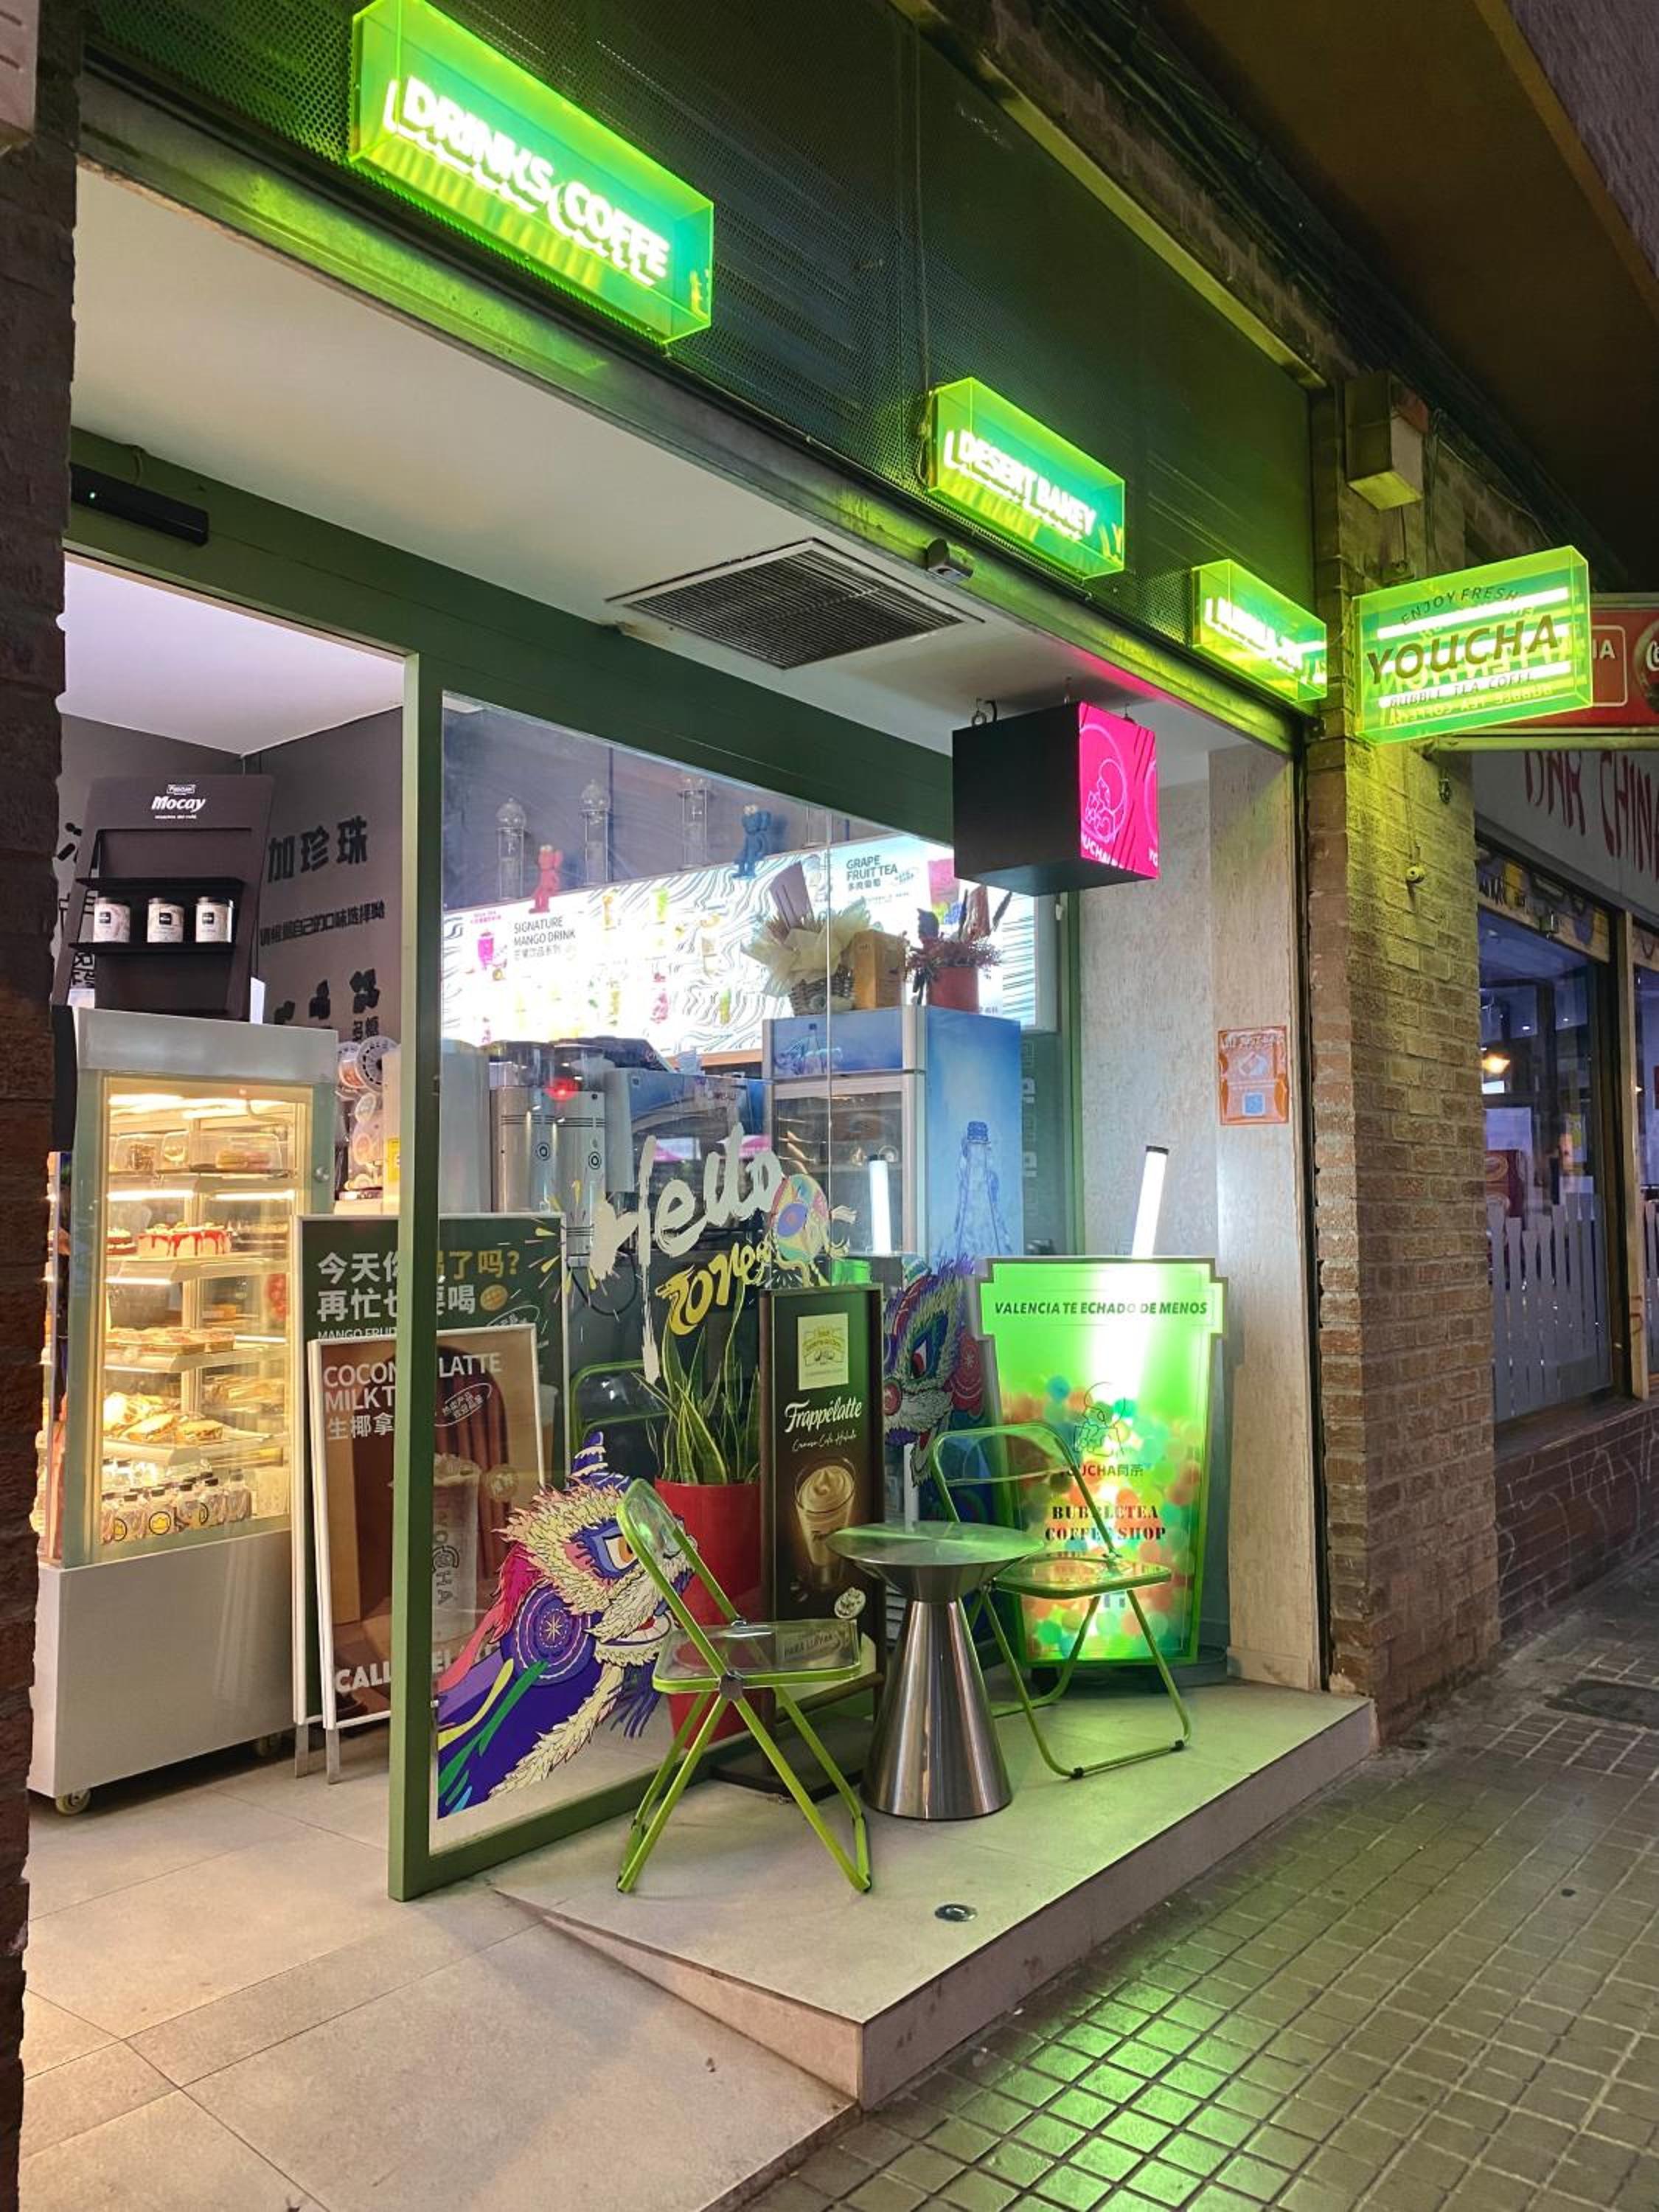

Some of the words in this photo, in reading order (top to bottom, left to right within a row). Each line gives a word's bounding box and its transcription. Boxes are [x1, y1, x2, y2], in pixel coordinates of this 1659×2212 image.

[1402, 591, 1455, 625] ENJOY
[1367, 613, 1559, 685] YOUCHA
[151, 796, 206, 813] Mocay
[846, 855, 881, 869] GRAPE
[846, 866, 879, 882] FRUIT
[879, 863, 898, 876] TEA
[514, 916, 563, 934] SIGNATURE
[514, 933, 546, 947] MANGO
[548, 929, 576, 943] DRINK
[995, 1301, 1060, 1315] VALENCIA
[1062, 1301, 1077, 1314] TE
[1080, 1301, 1137, 1315] ECHADO
[1139, 1301, 1157, 1314] DE
[1158, 1301, 1208, 1314] MENOS
[439, 1352, 503, 1378] LATTE
[325, 1386, 380, 1413] MILK
[1045, 1527, 1115, 1541] COFFE
[1117, 1526, 1166, 1541] SHOP
